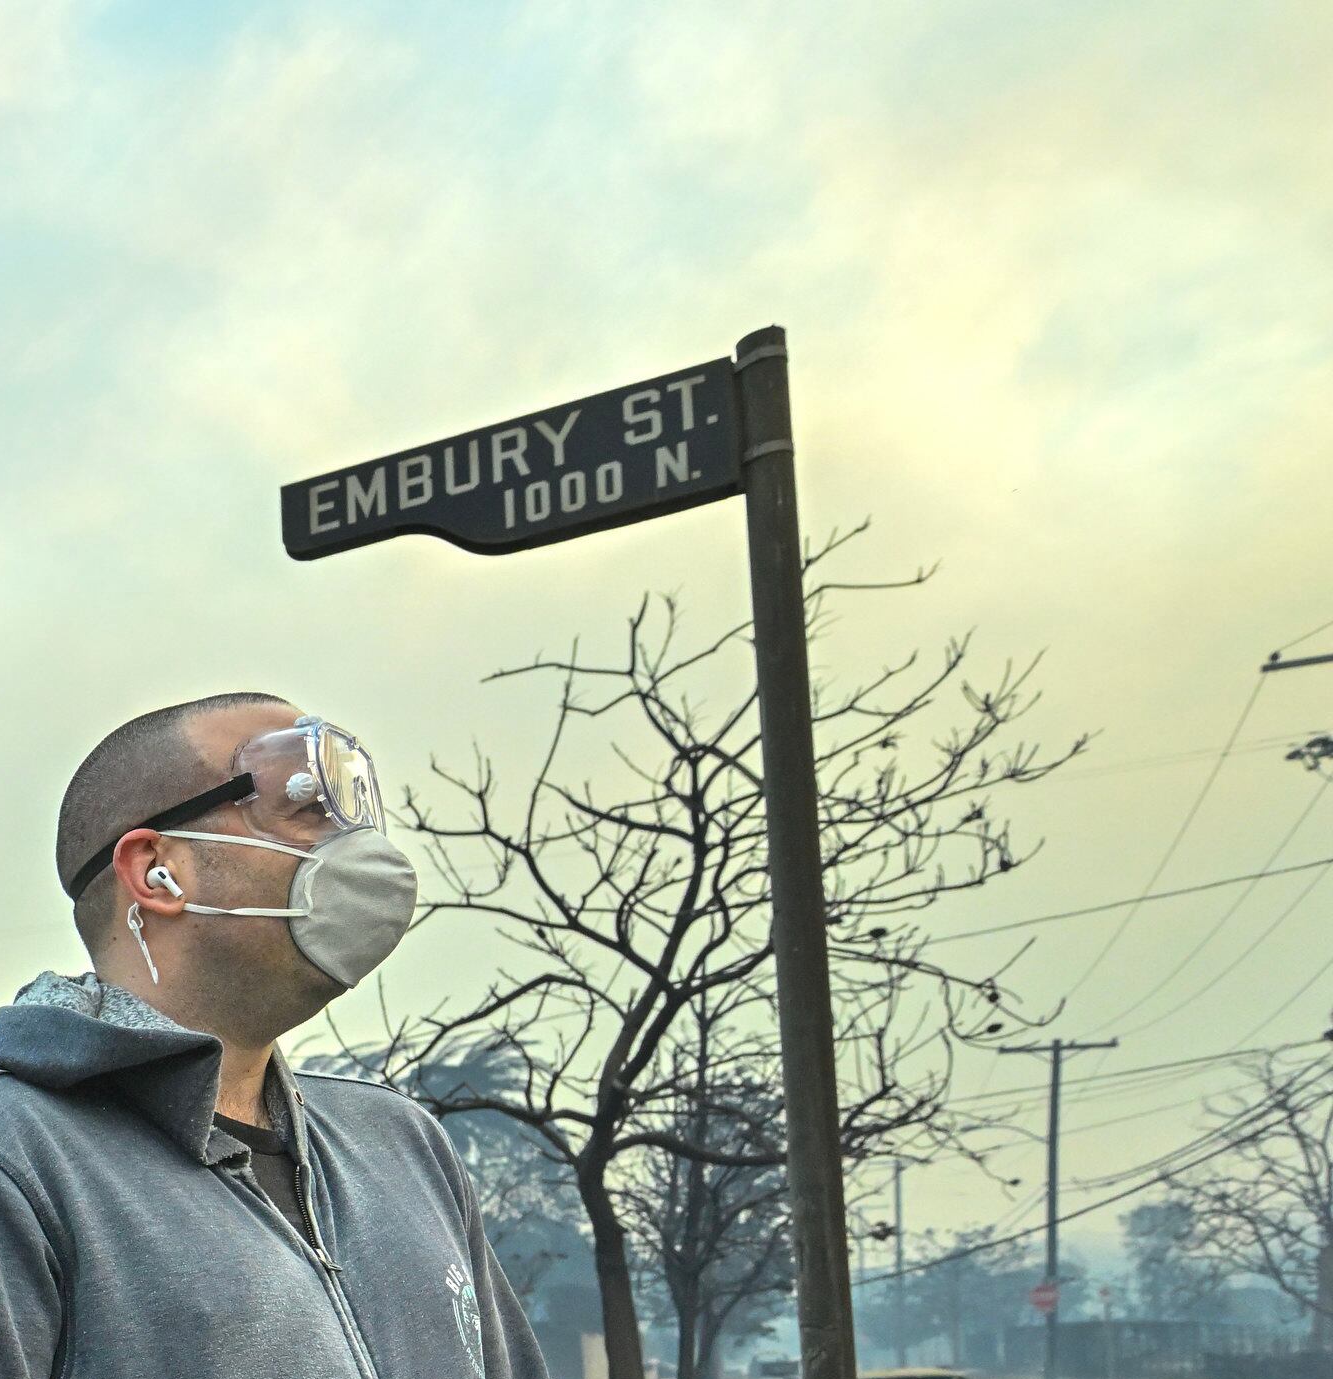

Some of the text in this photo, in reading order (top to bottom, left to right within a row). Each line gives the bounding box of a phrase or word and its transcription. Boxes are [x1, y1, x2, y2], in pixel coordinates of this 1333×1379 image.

[309, 374, 719, 535] EMBURY ST.
[503, 441, 702, 530] 1000 N.
[445, 1263, 464, 1295] BIG
